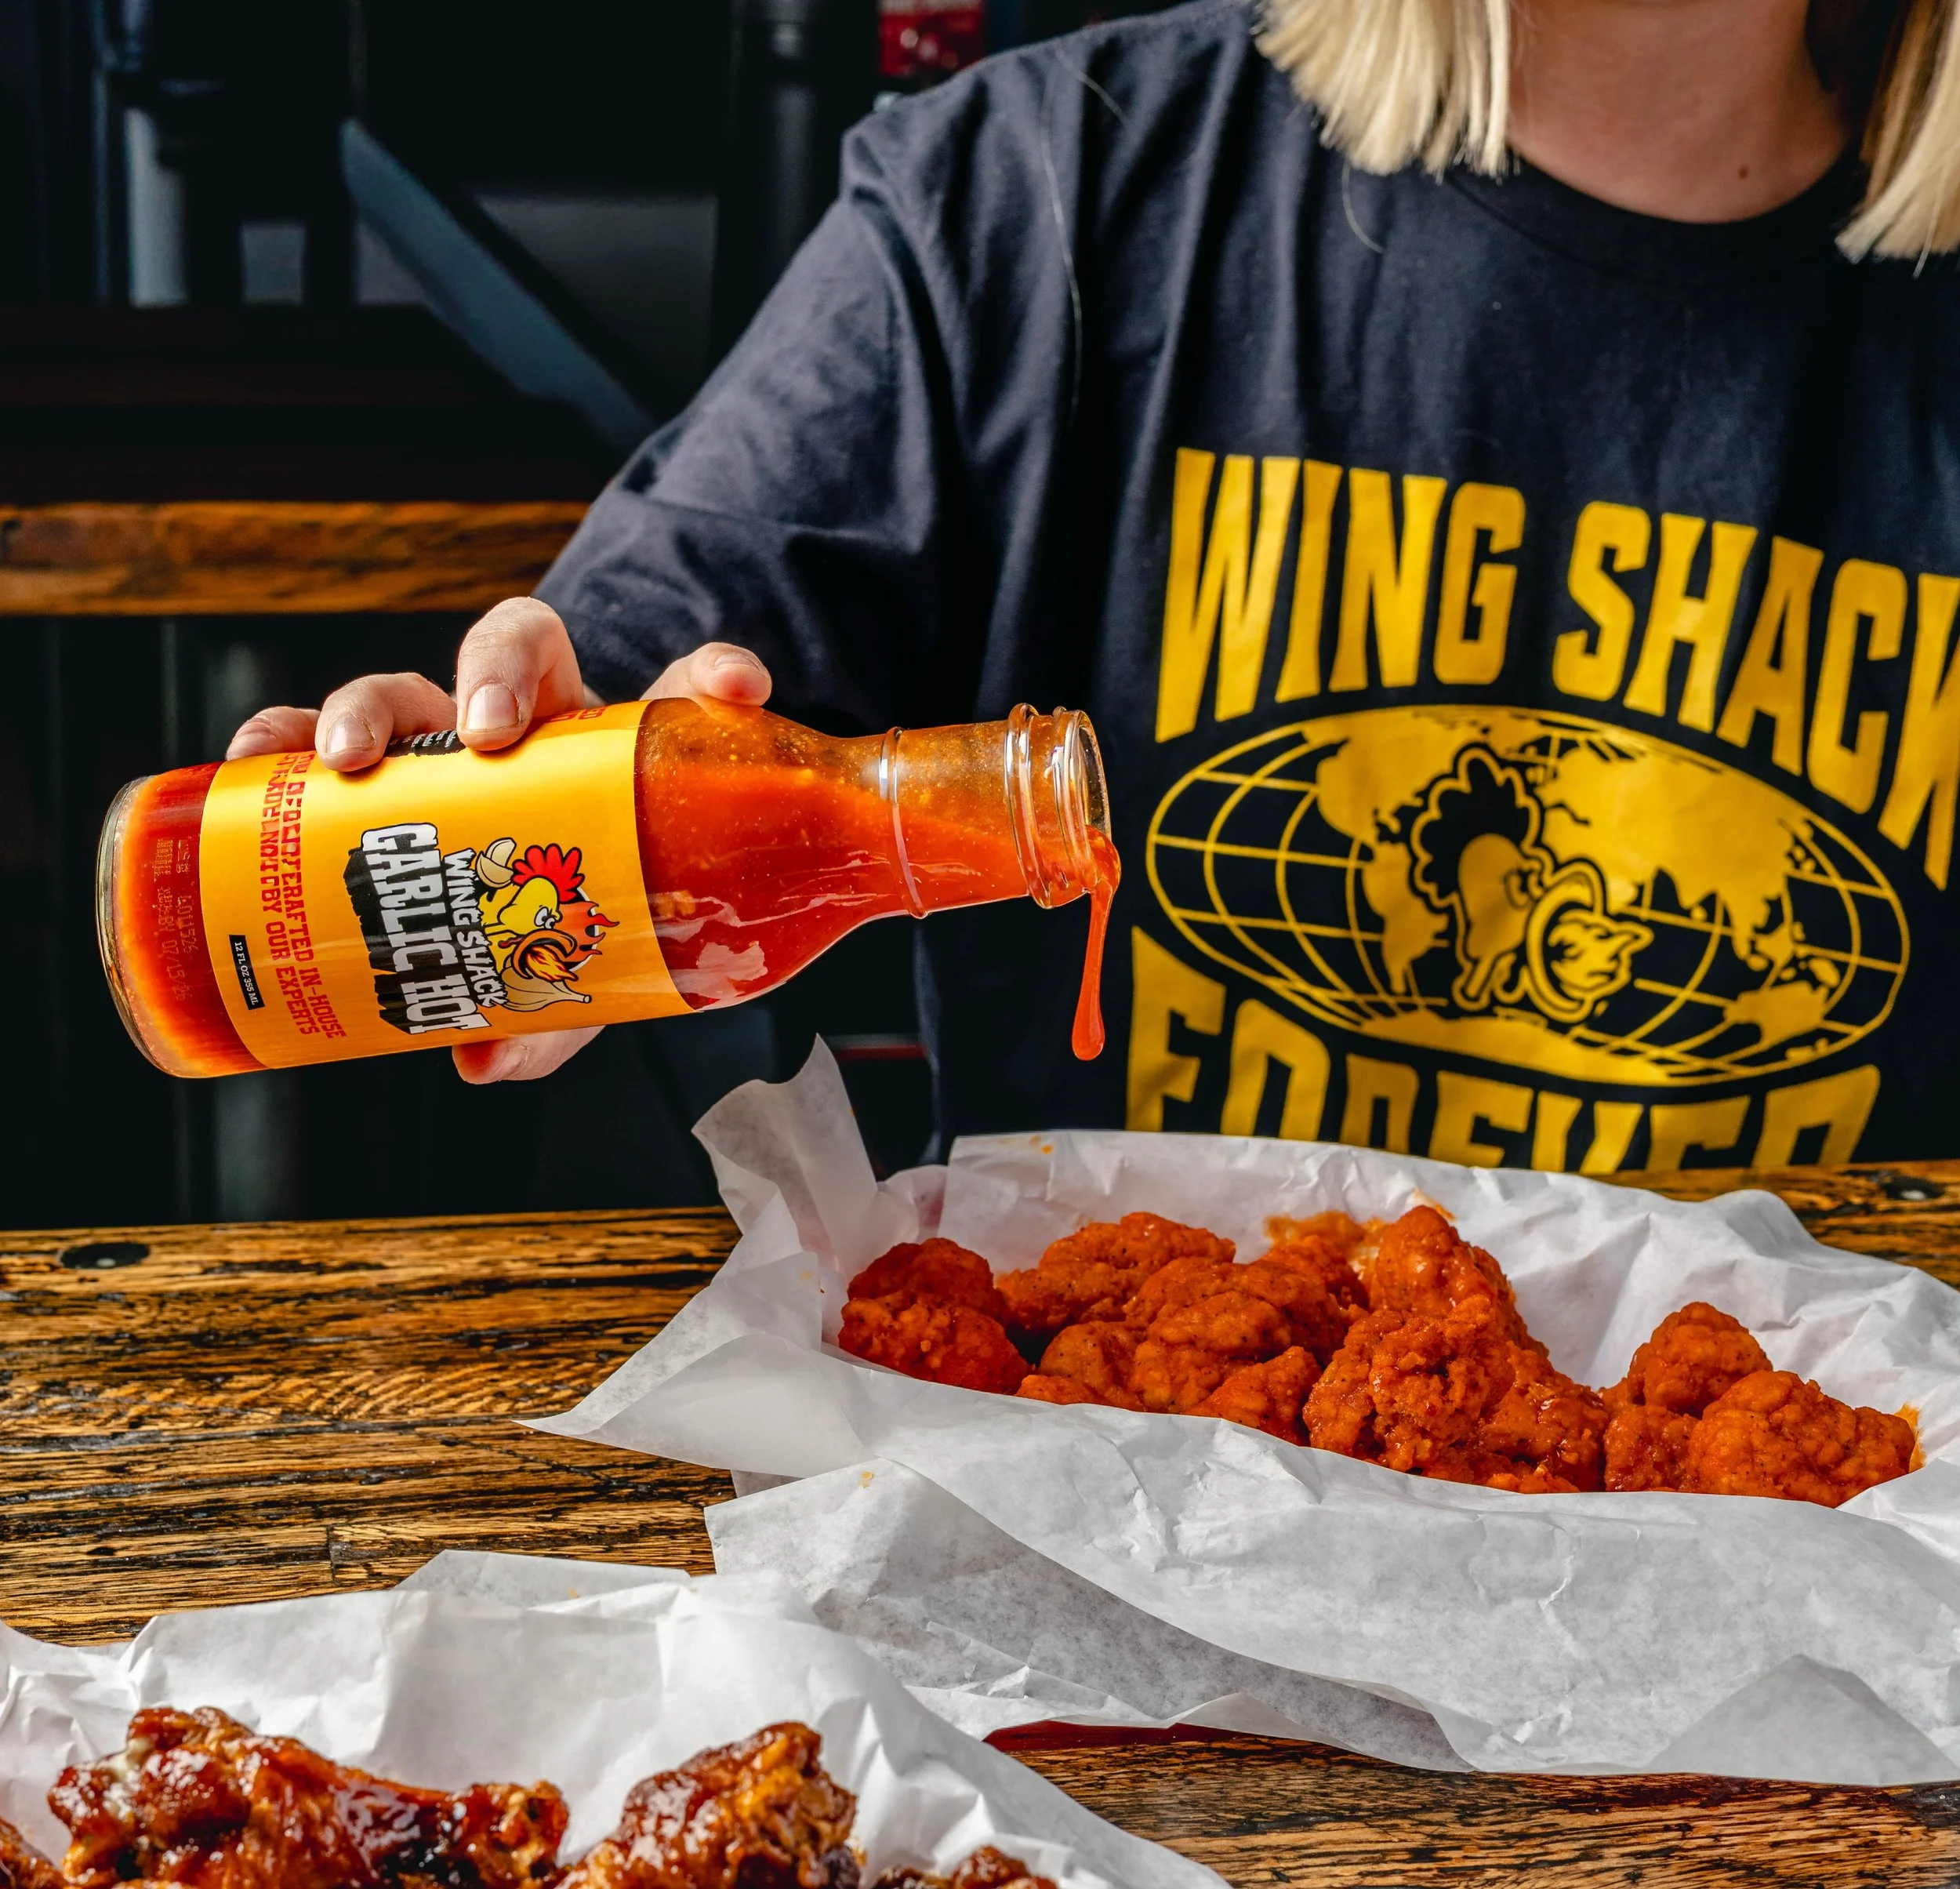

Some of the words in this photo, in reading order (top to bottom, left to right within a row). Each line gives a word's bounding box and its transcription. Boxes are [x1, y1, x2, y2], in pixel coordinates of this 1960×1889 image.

[1156, 447, 1526, 743] WING
[1552, 500, 1960, 891] SHACK
[361, 823, 458, 972] GARLIC
[444, 848, 481, 926] WING
[234, 941, 243, 952] 12
[237, 953, 246, 964] FL
[241, 965, 251, 977] OZ
[266, 921, 292, 961] OUR
[456, 930, 506, 1007] SHACK
[244, 978, 256, 992] 355
[249, 993, 259, 1005] ML
[275, 965, 321, 1035] EXPERTS
[299, 967, 347, 1039] IN-HOUSE
[401, 974, 492, 1035] HOT
